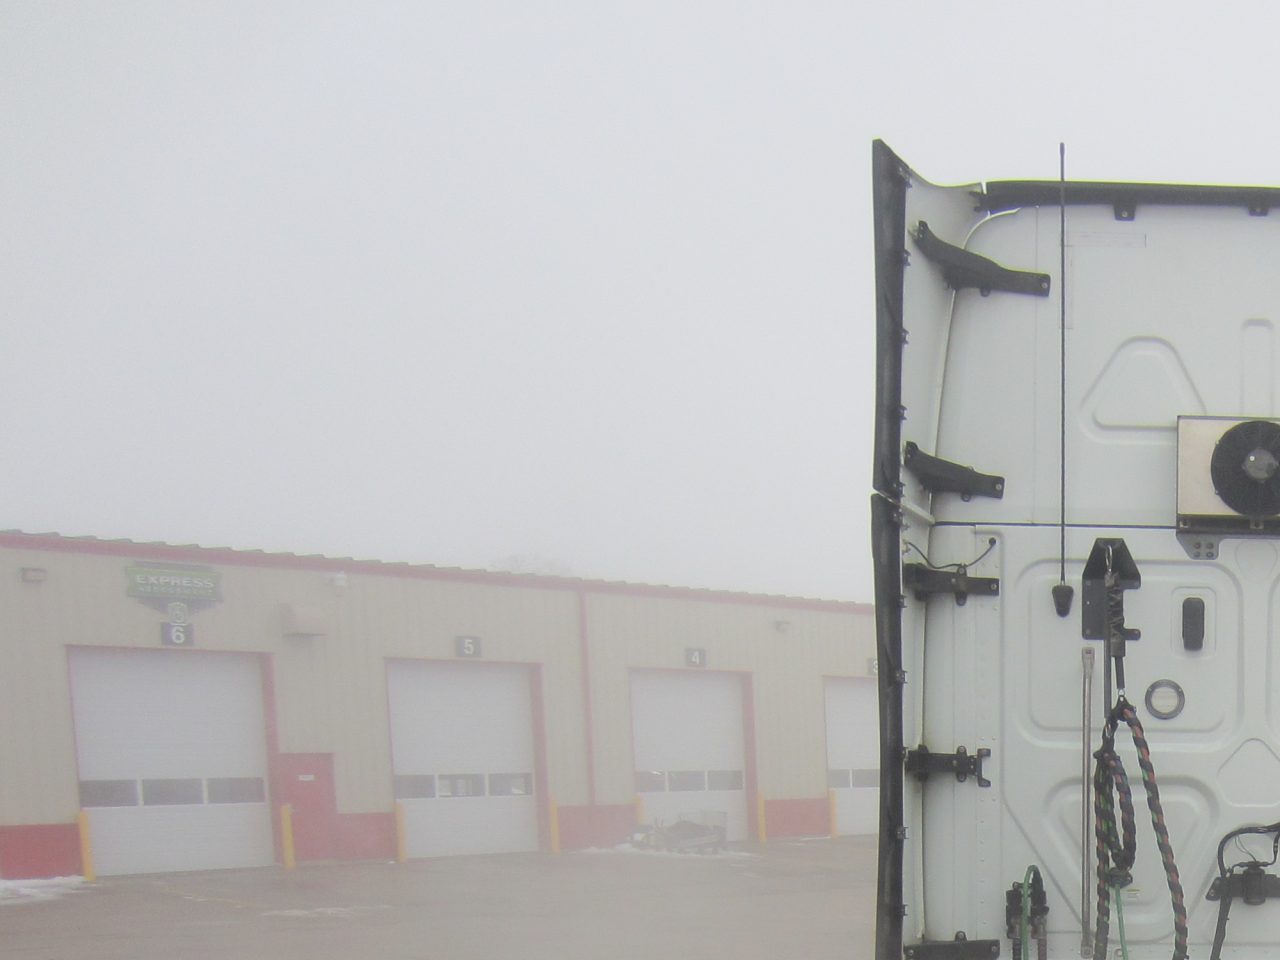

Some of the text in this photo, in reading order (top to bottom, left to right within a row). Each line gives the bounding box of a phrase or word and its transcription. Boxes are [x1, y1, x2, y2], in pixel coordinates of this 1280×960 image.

[135, 574, 215, 588] EXPRESS
[171, 625, 186, 644] 6
[463, 639, 475, 655] 5
[691, 650, 700, 665] 4
